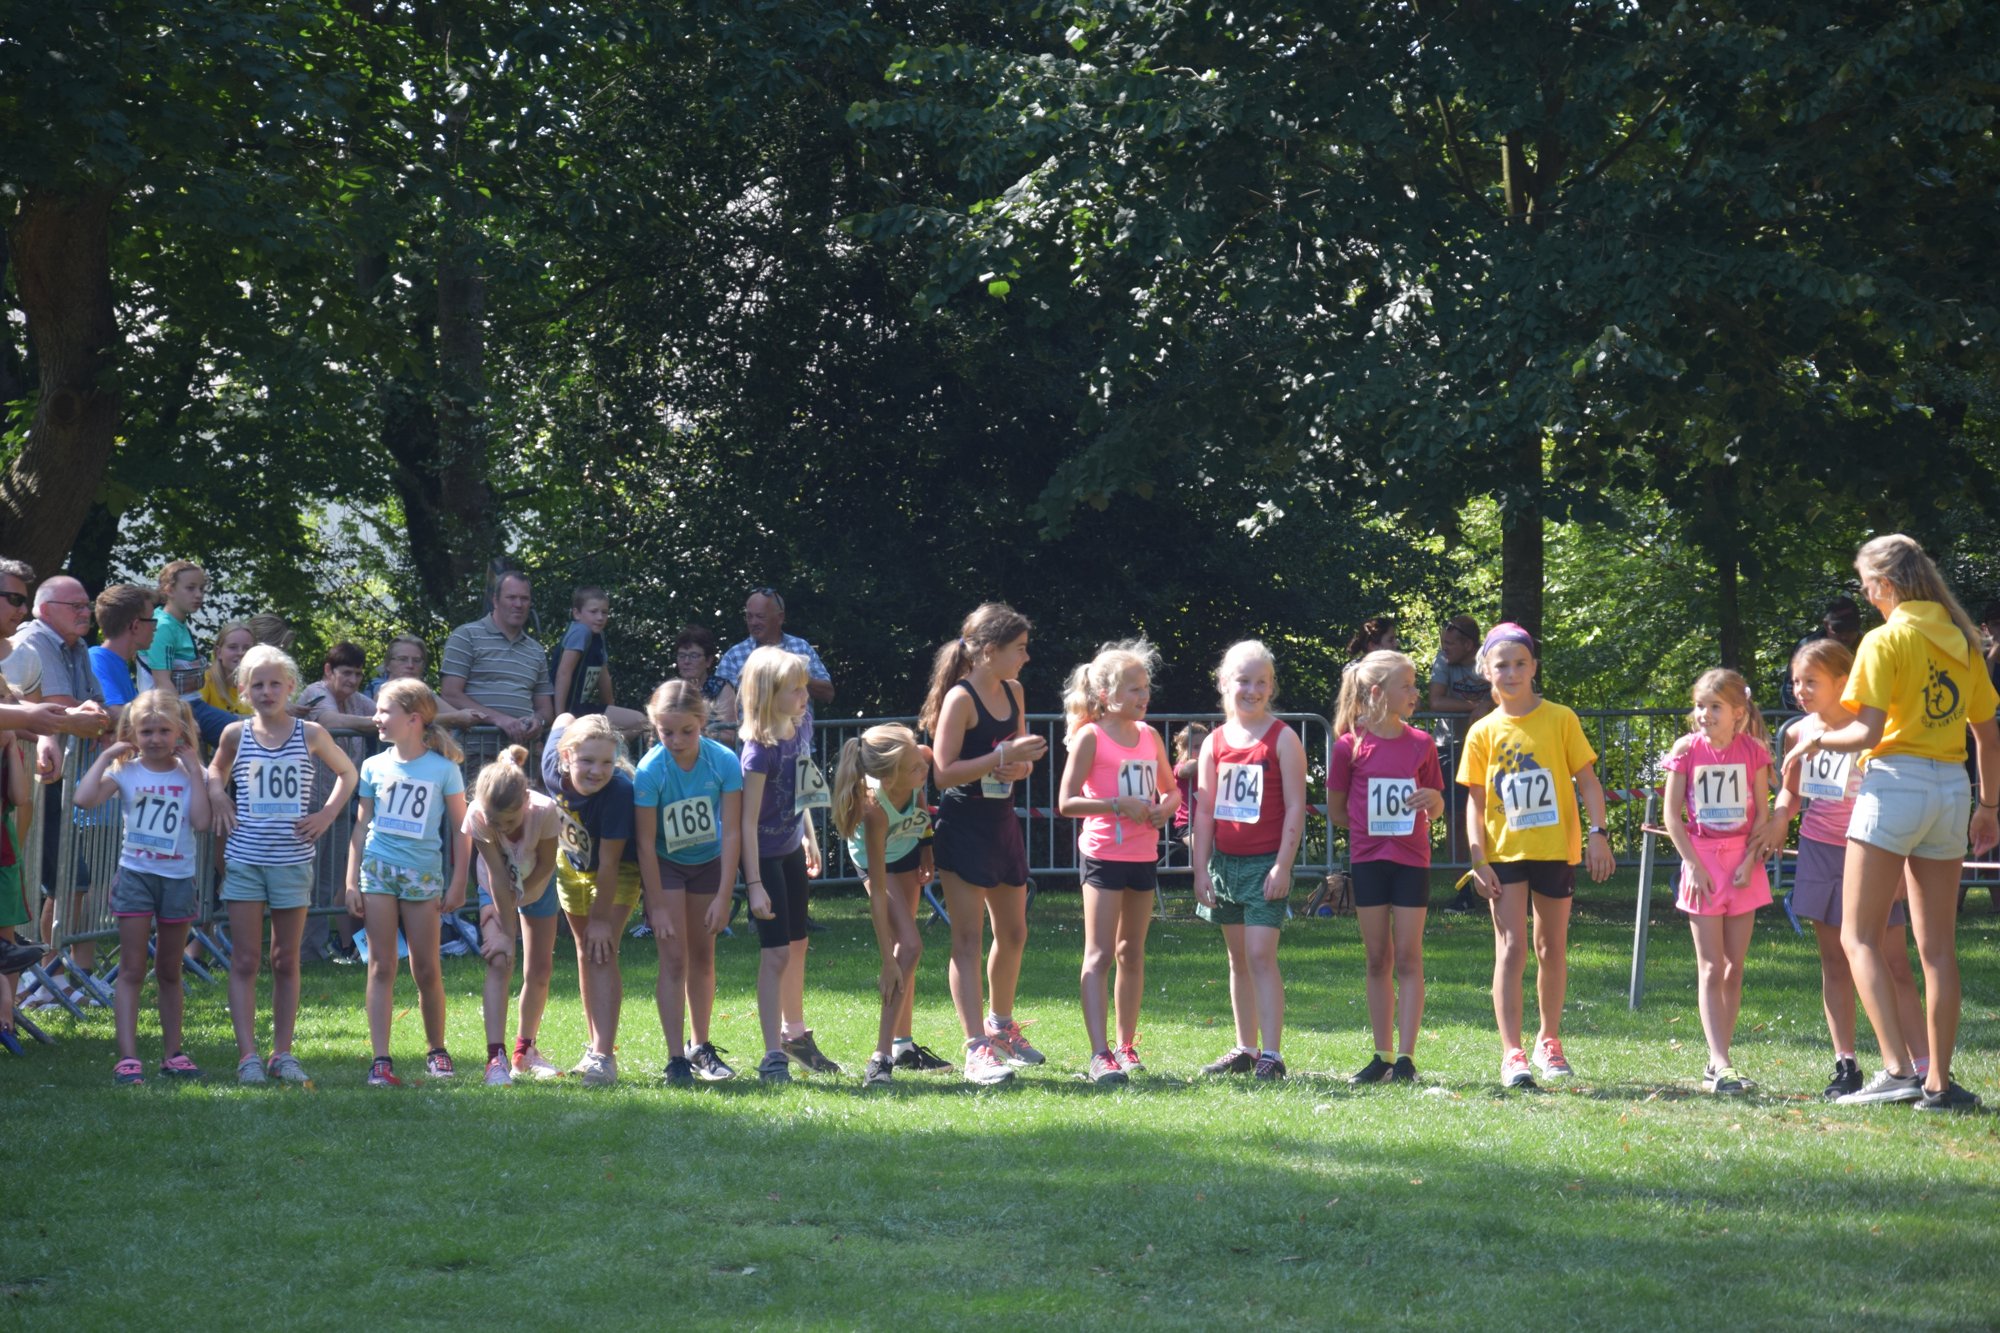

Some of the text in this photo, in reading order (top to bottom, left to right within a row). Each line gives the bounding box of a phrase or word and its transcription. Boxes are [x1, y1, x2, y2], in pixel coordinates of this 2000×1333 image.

[254, 765, 298, 799] 166
[1121, 764, 1155, 797] 170
[1222, 769, 1259, 803] 164
[1507, 774, 1552, 811] 172
[1698, 769, 1739, 804] 171
[135, 796, 179, 834] 176
[386, 781, 428, 819] 178
[1372, 783, 1414, 816] 169
[667, 801, 711, 838] 168
